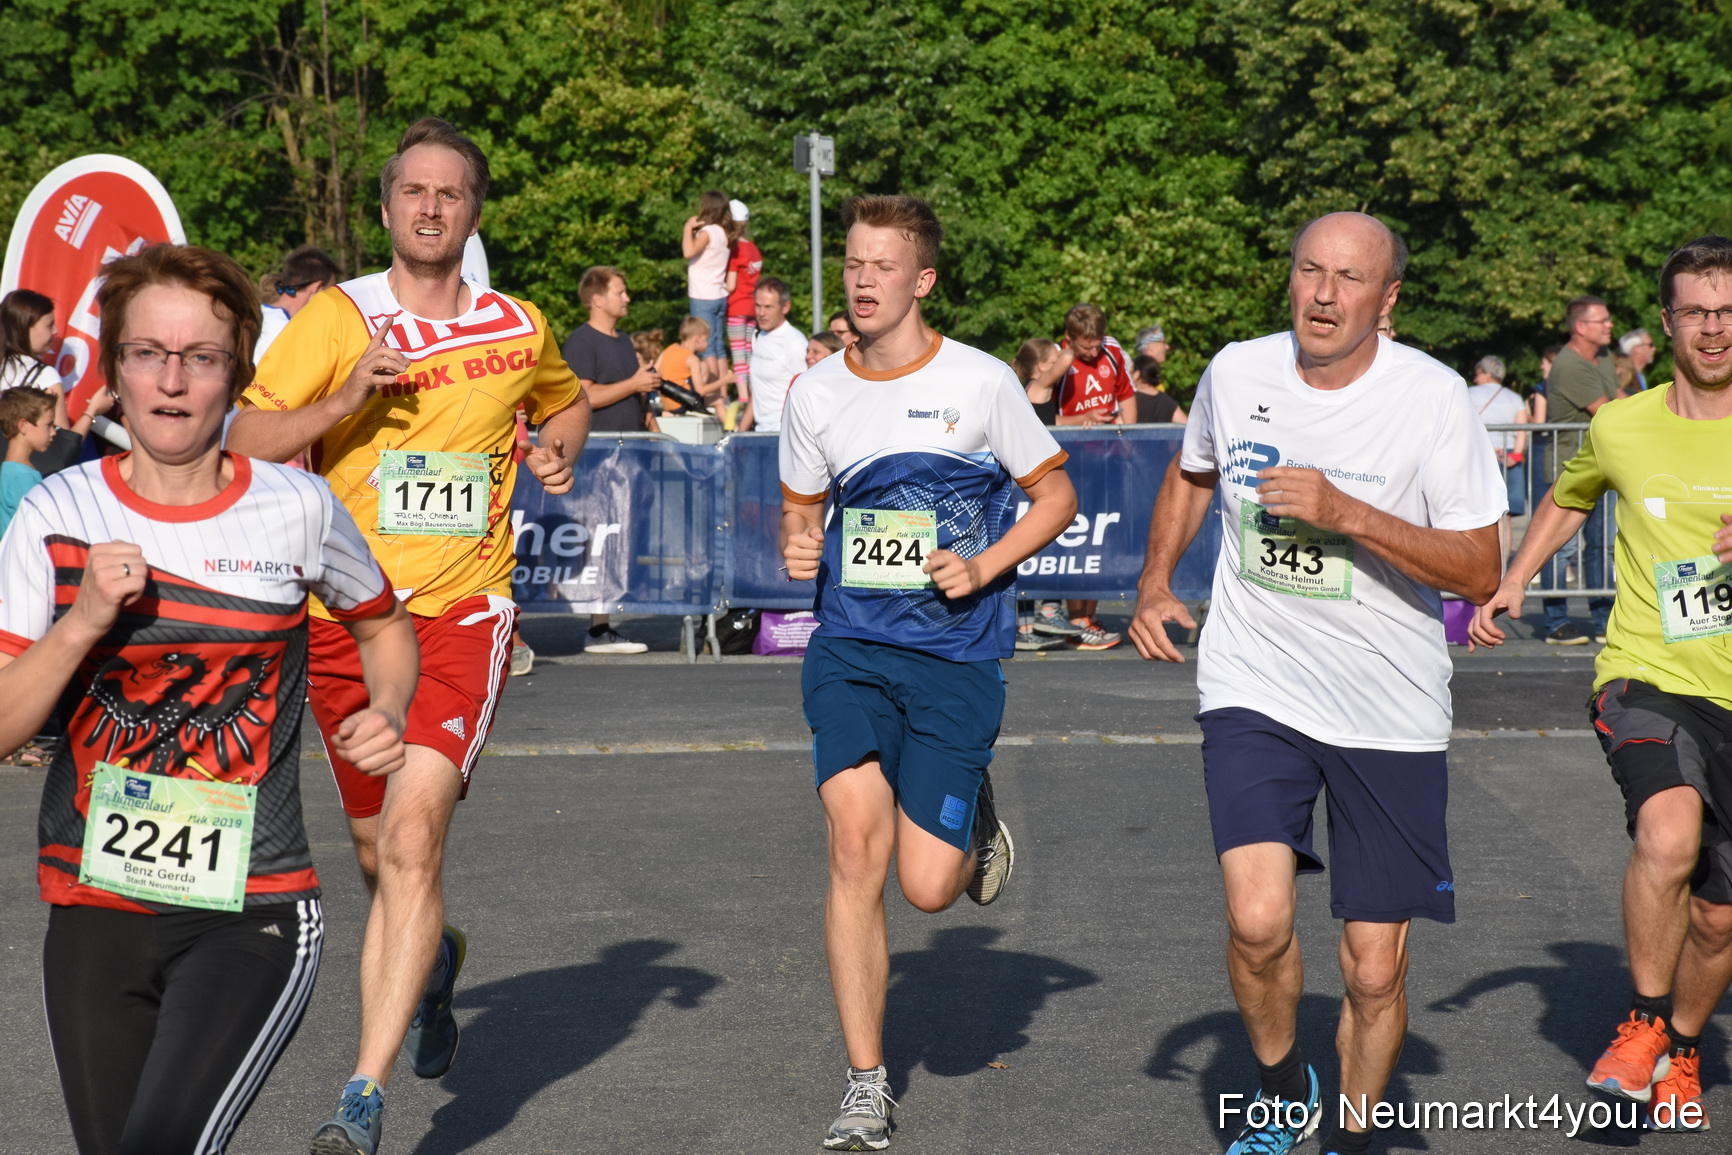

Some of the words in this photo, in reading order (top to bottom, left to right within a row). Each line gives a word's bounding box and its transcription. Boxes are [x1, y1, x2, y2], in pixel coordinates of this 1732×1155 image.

[54, 194, 89, 241] AVIA
[381, 364, 455, 399] MAX
[463, 347, 538, 380] BÖGL
[1249, 414, 1270, 424] erima
[397, 467, 442, 477] firmenlauf
[466, 475, 484, 483] 2019
[395, 481, 473, 512] 1711
[854, 524, 889, 533] firmenlauf
[852, 537, 924, 566] 2424
[1259, 537, 1324, 575] 343
[204, 559, 291, 576] NEUMARKT
[1260, 566, 1289, 581] Kobras
[1291, 574, 1324, 585] Helmut
[1247, 569, 1296, 589] Breitbandberatung
[1296, 584, 1319, 592] Bayern
[1671, 571, 1715, 585] firmenlauf
[1672, 583, 1732, 618] 119
[1689, 617, 1710, 626] Auer
[1691, 624, 1718, 632] Klinikum
[112, 790, 175, 814] firmenlauf
[212, 816, 242, 829] 2019
[101, 812, 222, 872] 2241
[124, 862, 154, 878] Benz
[157, 868, 196, 884] Gerda
[125, 875, 147, 887] Stadt
[148, 879, 190, 893] Neumarkt
